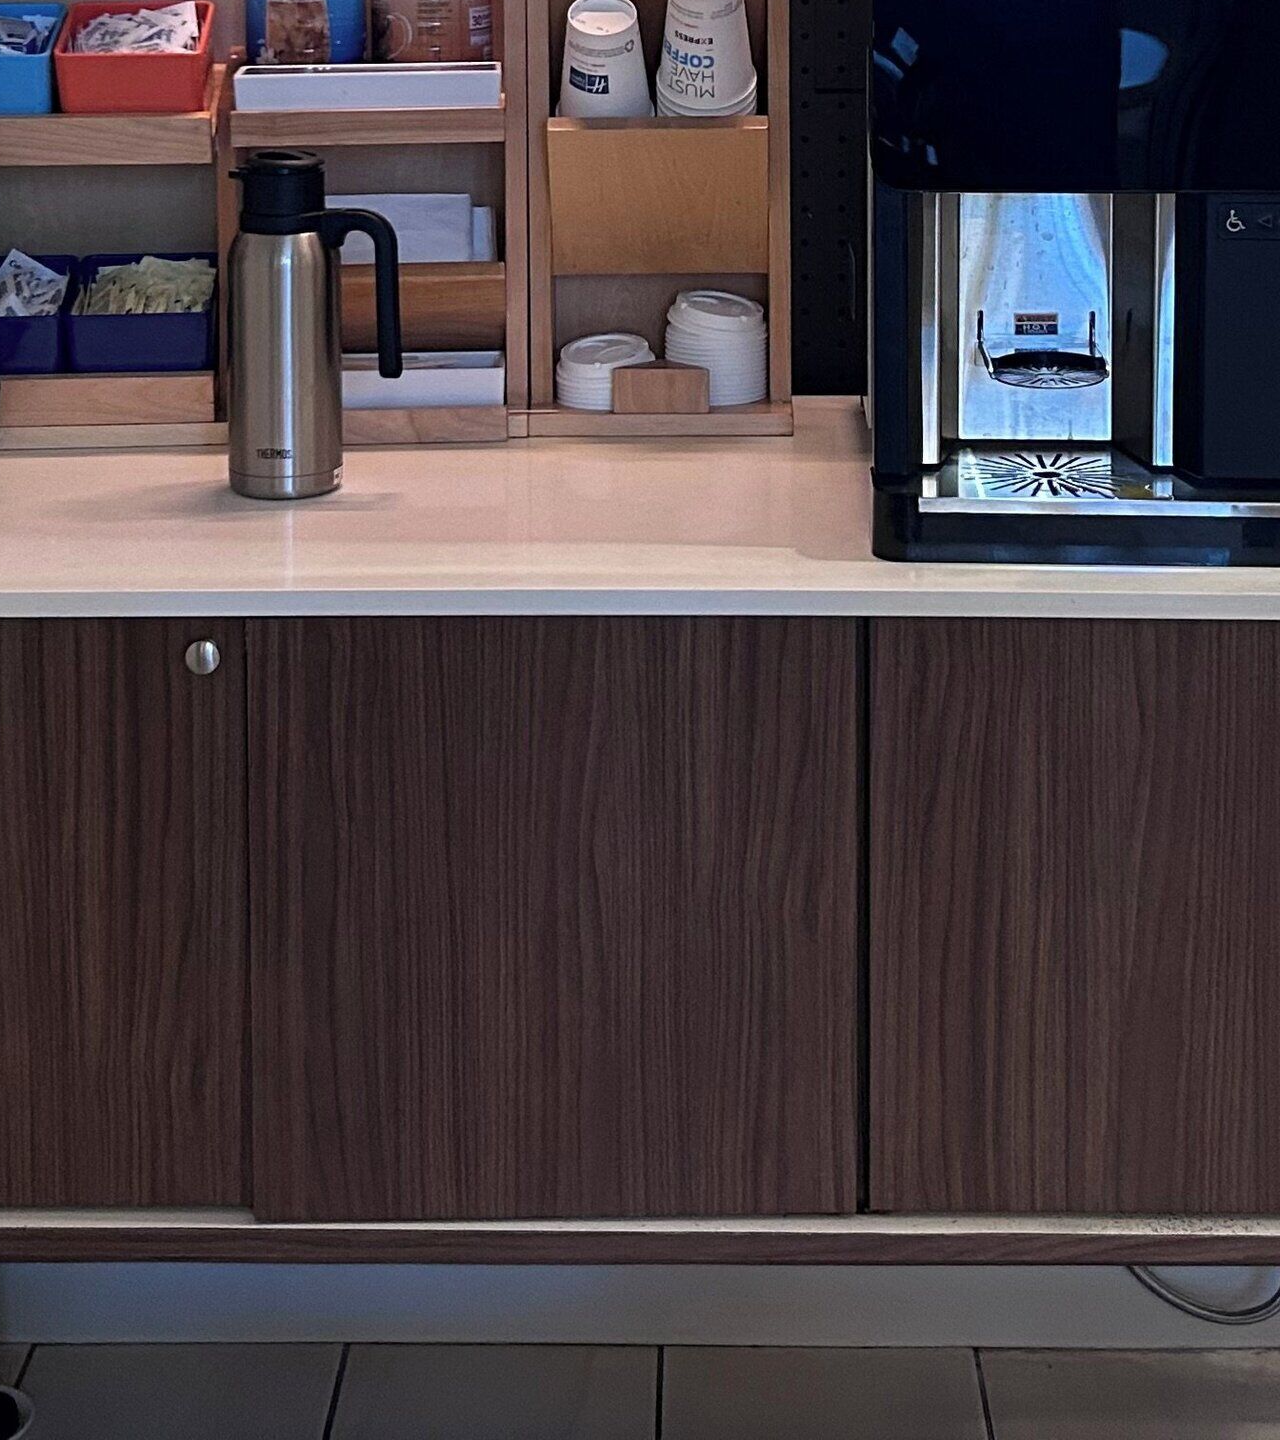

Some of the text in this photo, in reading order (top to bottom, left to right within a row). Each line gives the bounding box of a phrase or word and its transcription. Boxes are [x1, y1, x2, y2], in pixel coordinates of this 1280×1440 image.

[675, 30, 714, 45] EXPRESS
[664, 39, 715, 69] COFFE
[257, 448, 292, 459] THERMOS
